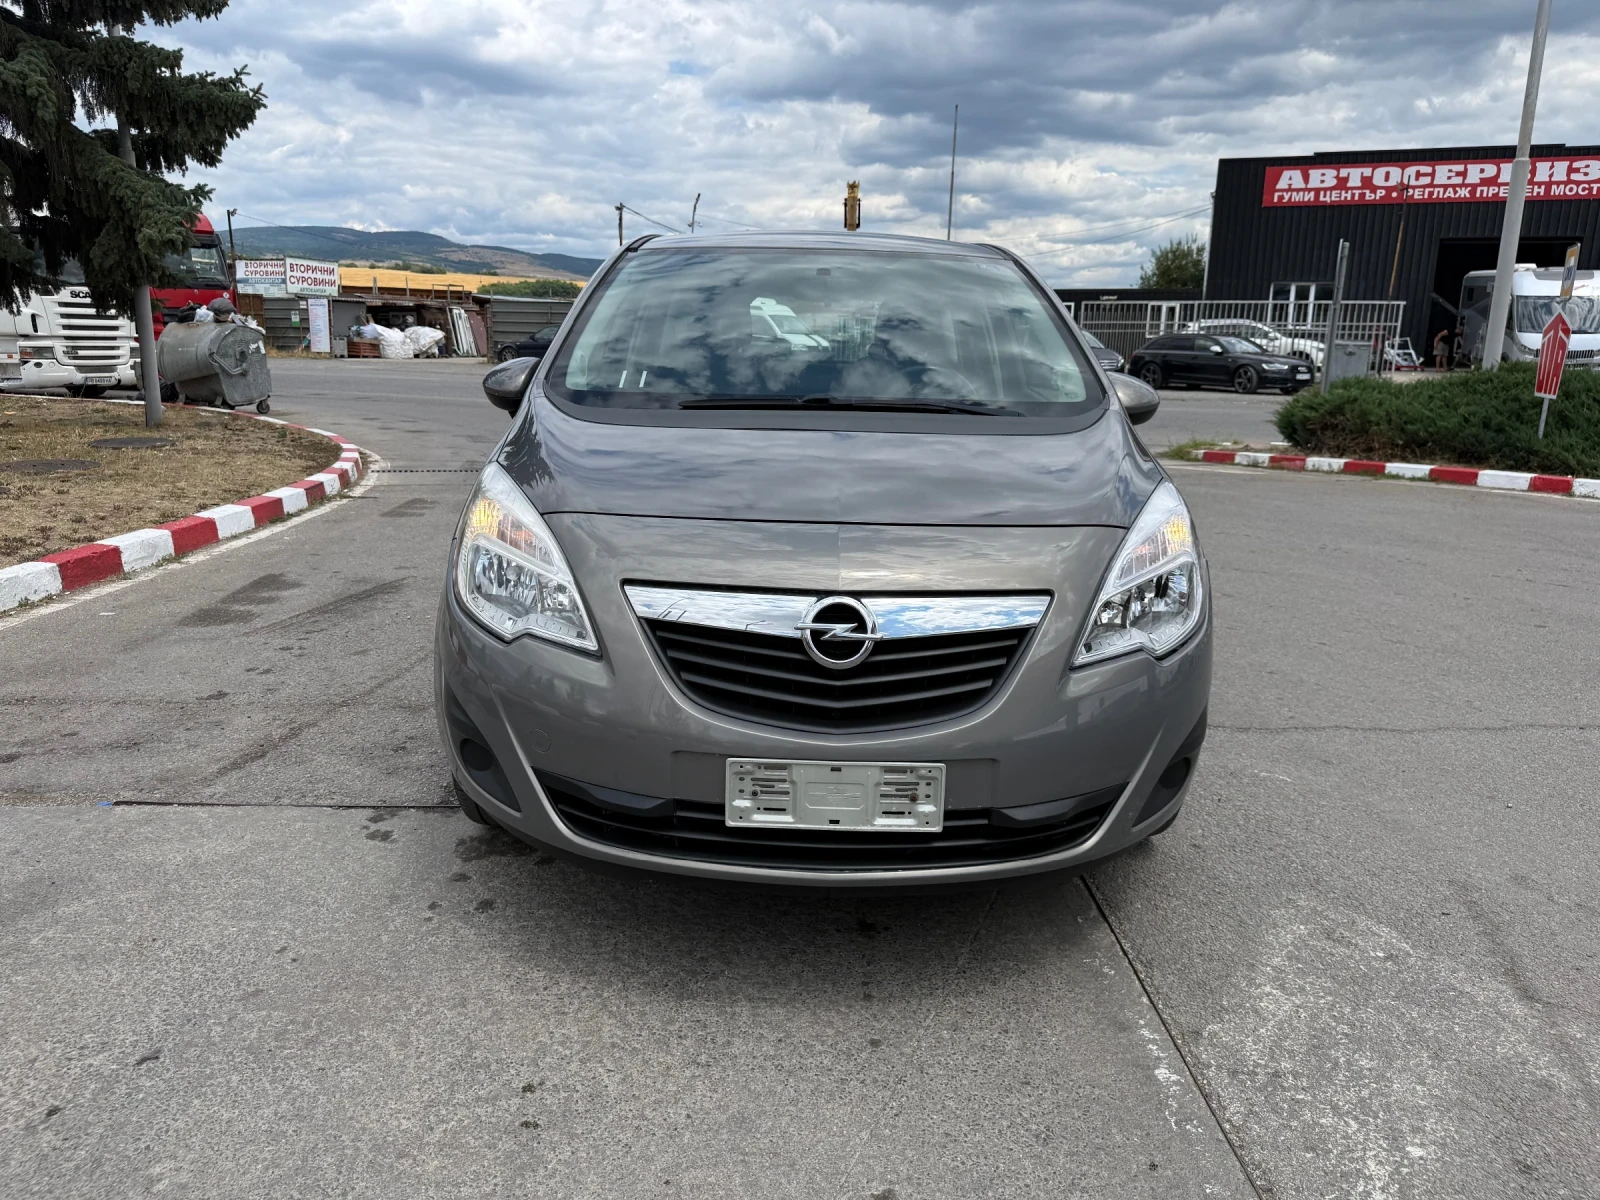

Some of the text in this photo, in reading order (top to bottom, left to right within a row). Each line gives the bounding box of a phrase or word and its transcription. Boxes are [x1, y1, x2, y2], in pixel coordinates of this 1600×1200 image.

[1273, 183, 1600, 203] ГУМИ ЦЕНТЪР РЕГЛАЖ ПРЕЕН МОСТ
[244, 261, 284, 269] ВТОРИЧНИ
[289, 263, 335, 276] ВТОРИЧНИ
[244, 269, 286, 277] СУРОВИНИ
[289, 275, 336, 287] СУРОВИНИ
